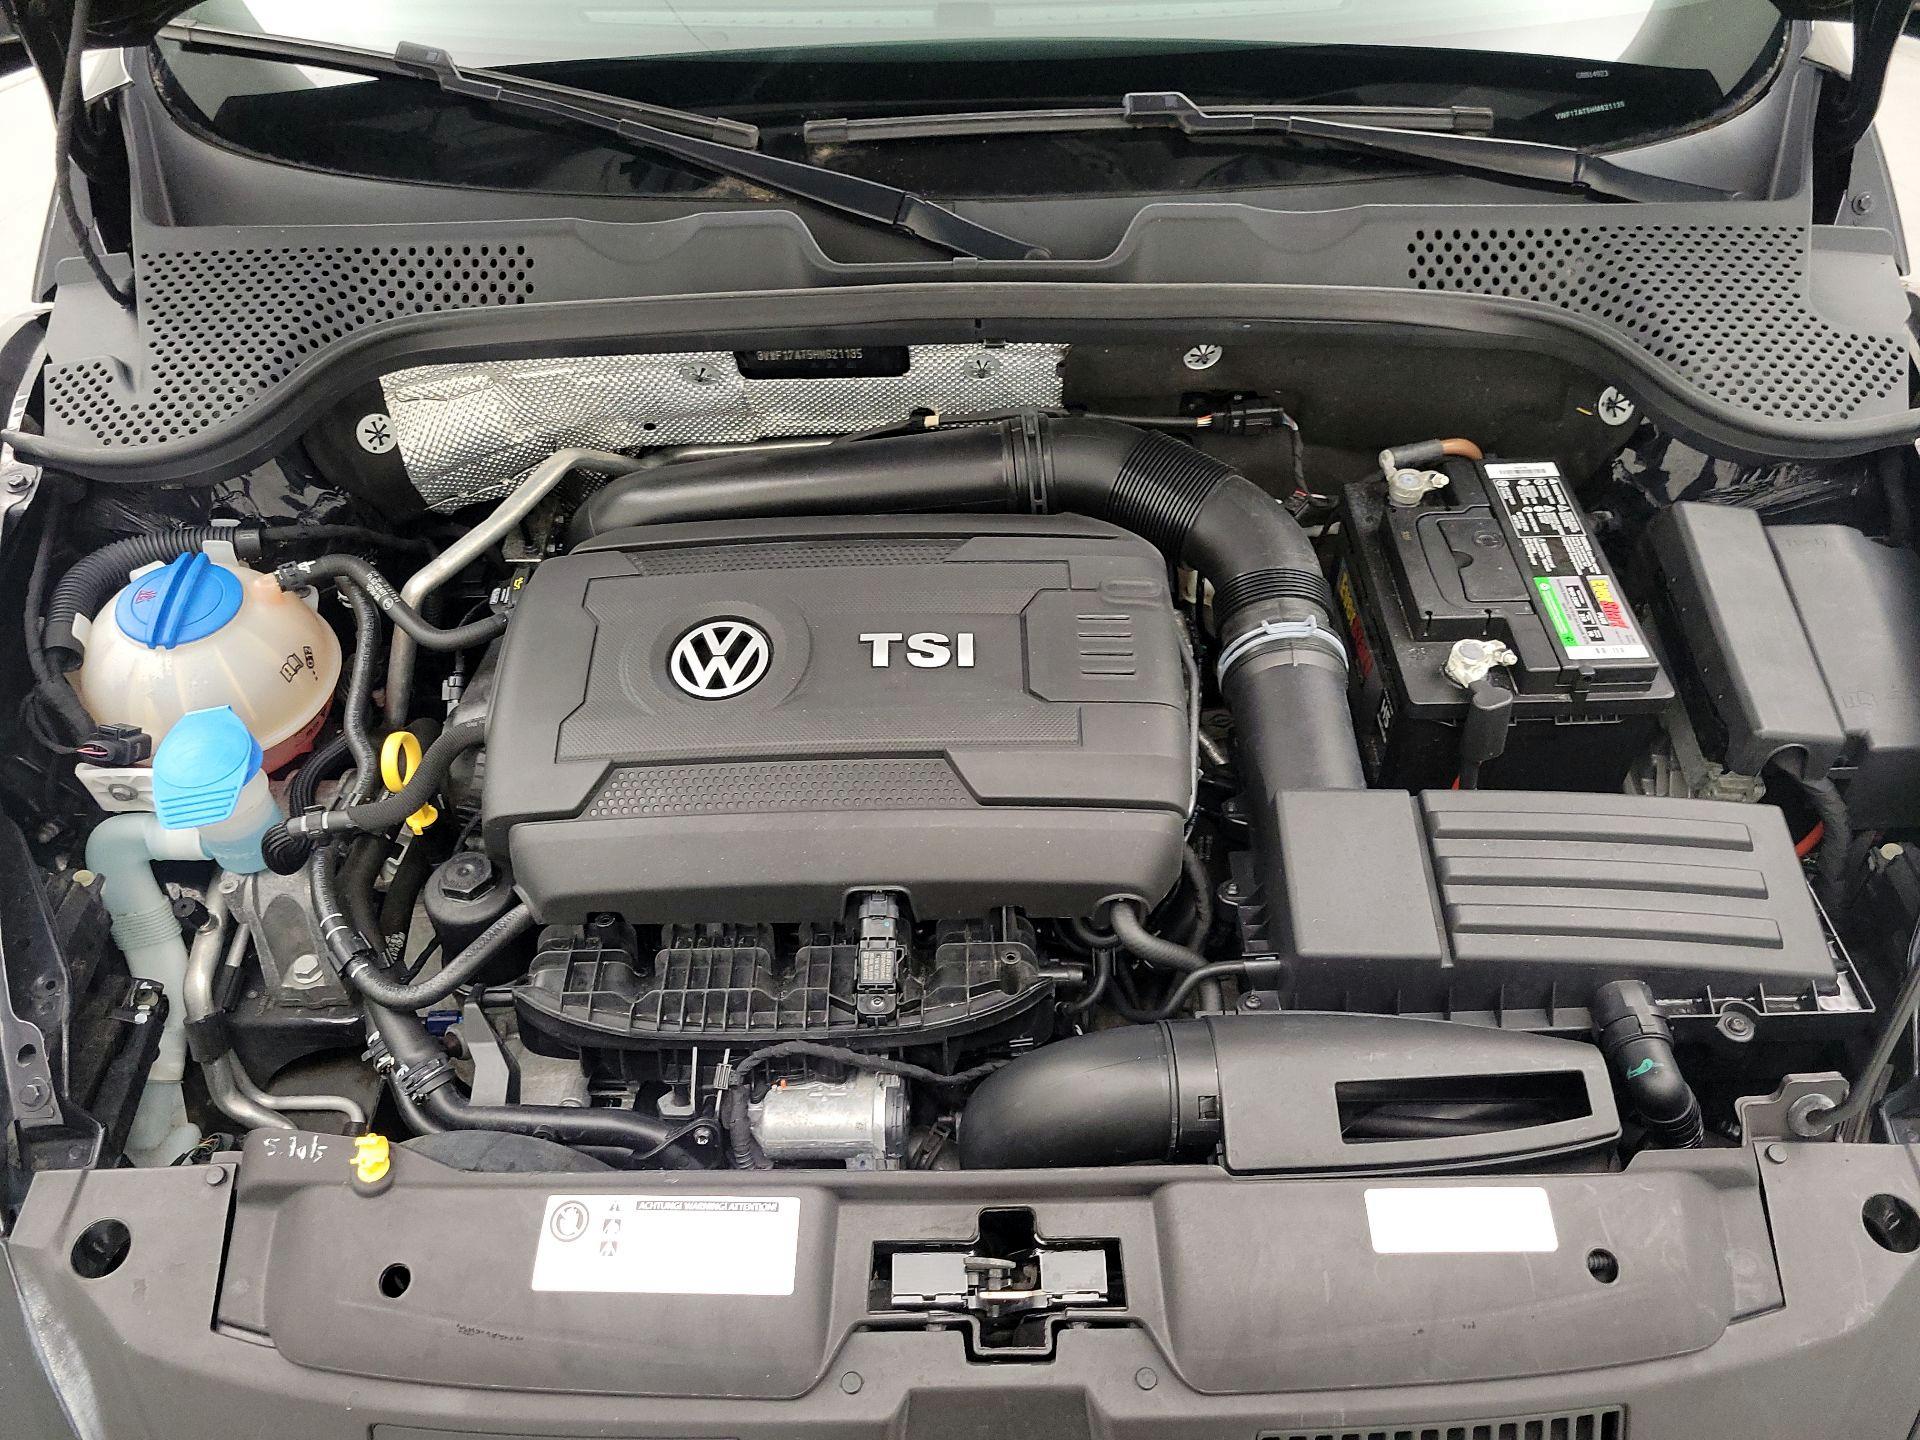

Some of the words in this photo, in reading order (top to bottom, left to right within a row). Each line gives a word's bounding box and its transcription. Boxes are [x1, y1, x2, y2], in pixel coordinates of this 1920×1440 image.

[859, 632, 975, 668] TSI
[639, 1201, 682, 1210] ACHTUNG!
[684, 1202, 727, 1211] WARNING!
